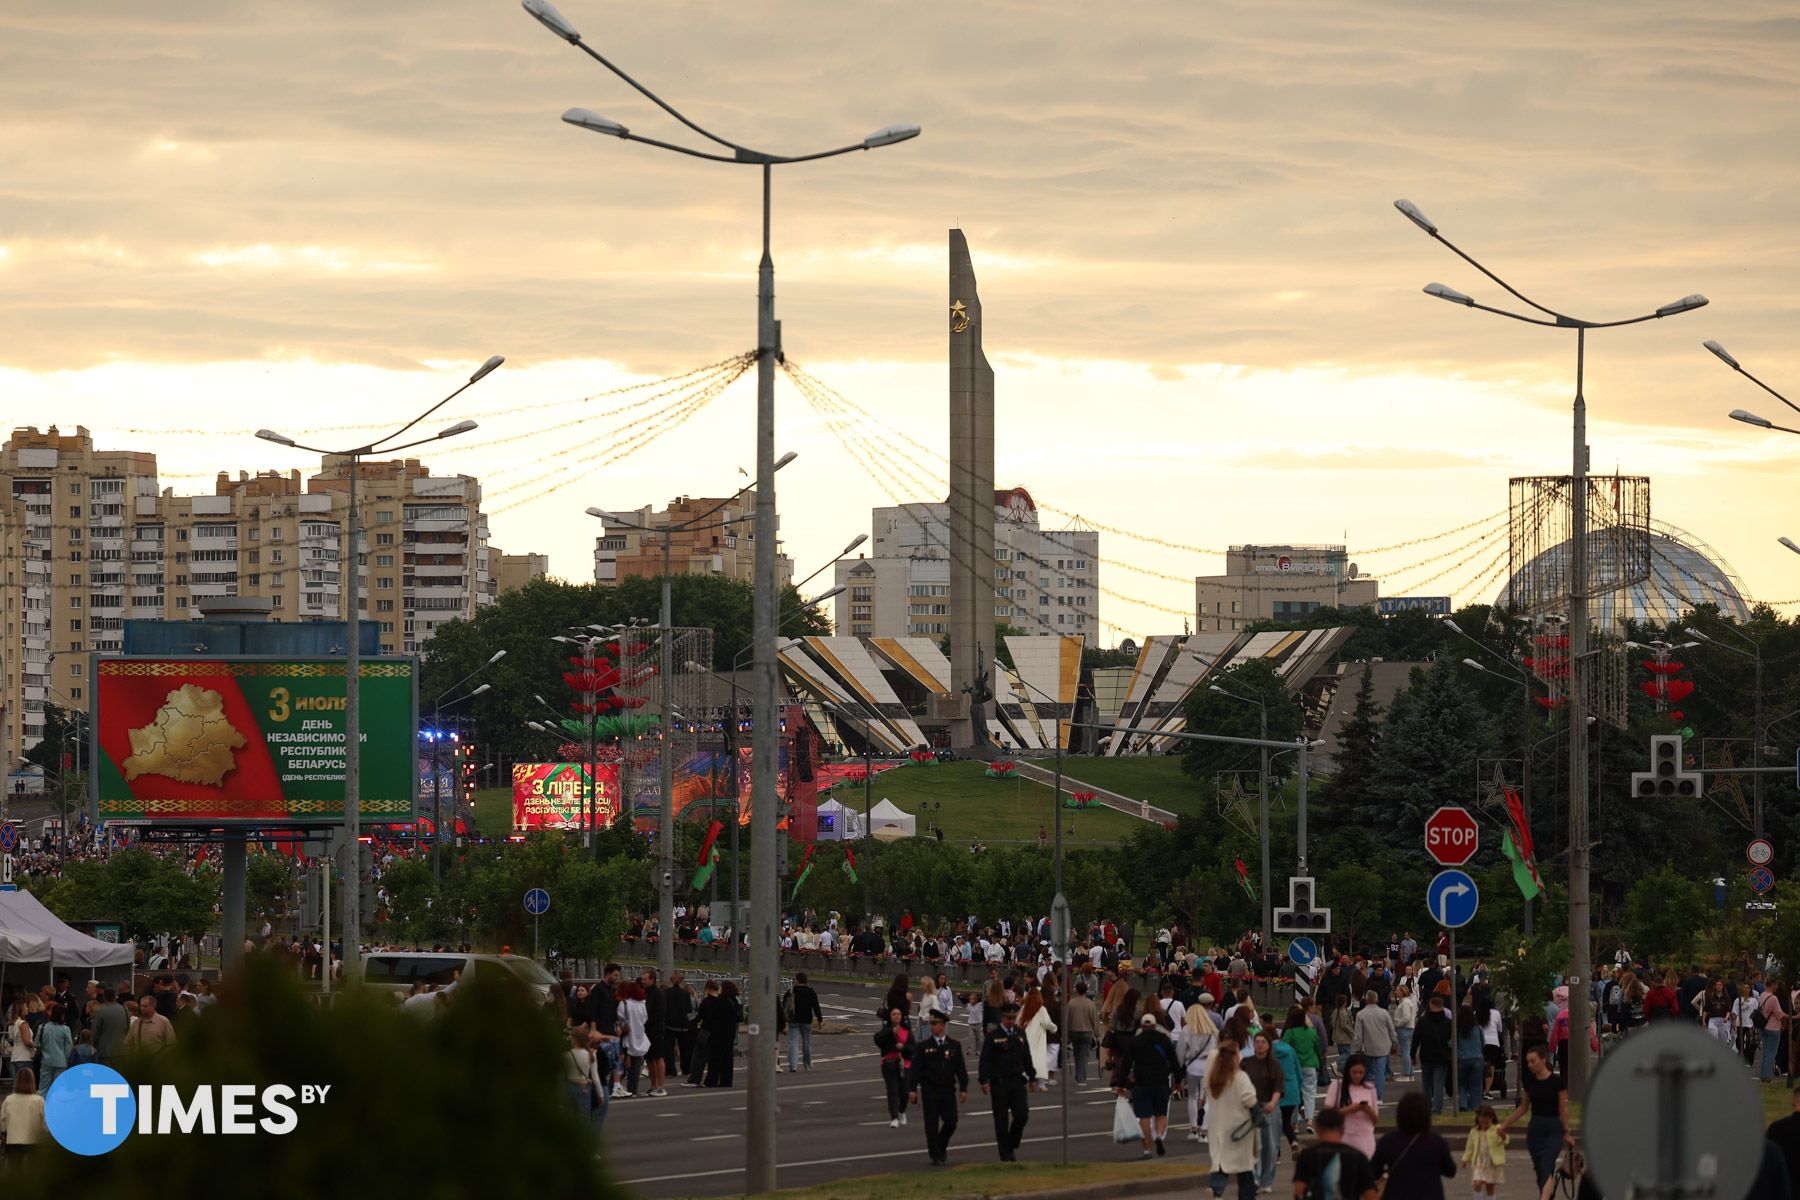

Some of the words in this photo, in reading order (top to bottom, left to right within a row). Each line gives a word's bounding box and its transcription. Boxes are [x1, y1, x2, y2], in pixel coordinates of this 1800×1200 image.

[269, 687, 290, 721] 3
[302, 720, 333, 731] ДЕНЬ
[267, 733, 367, 742] НЕЗАВИСИМОИ
[280, 746, 347, 756] РЕСПУБЛИК
[288, 760, 347, 769] БЕЛАРУСЬ
[532, 779, 544, 795] 3
[1429, 827, 1475, 846] STOP
